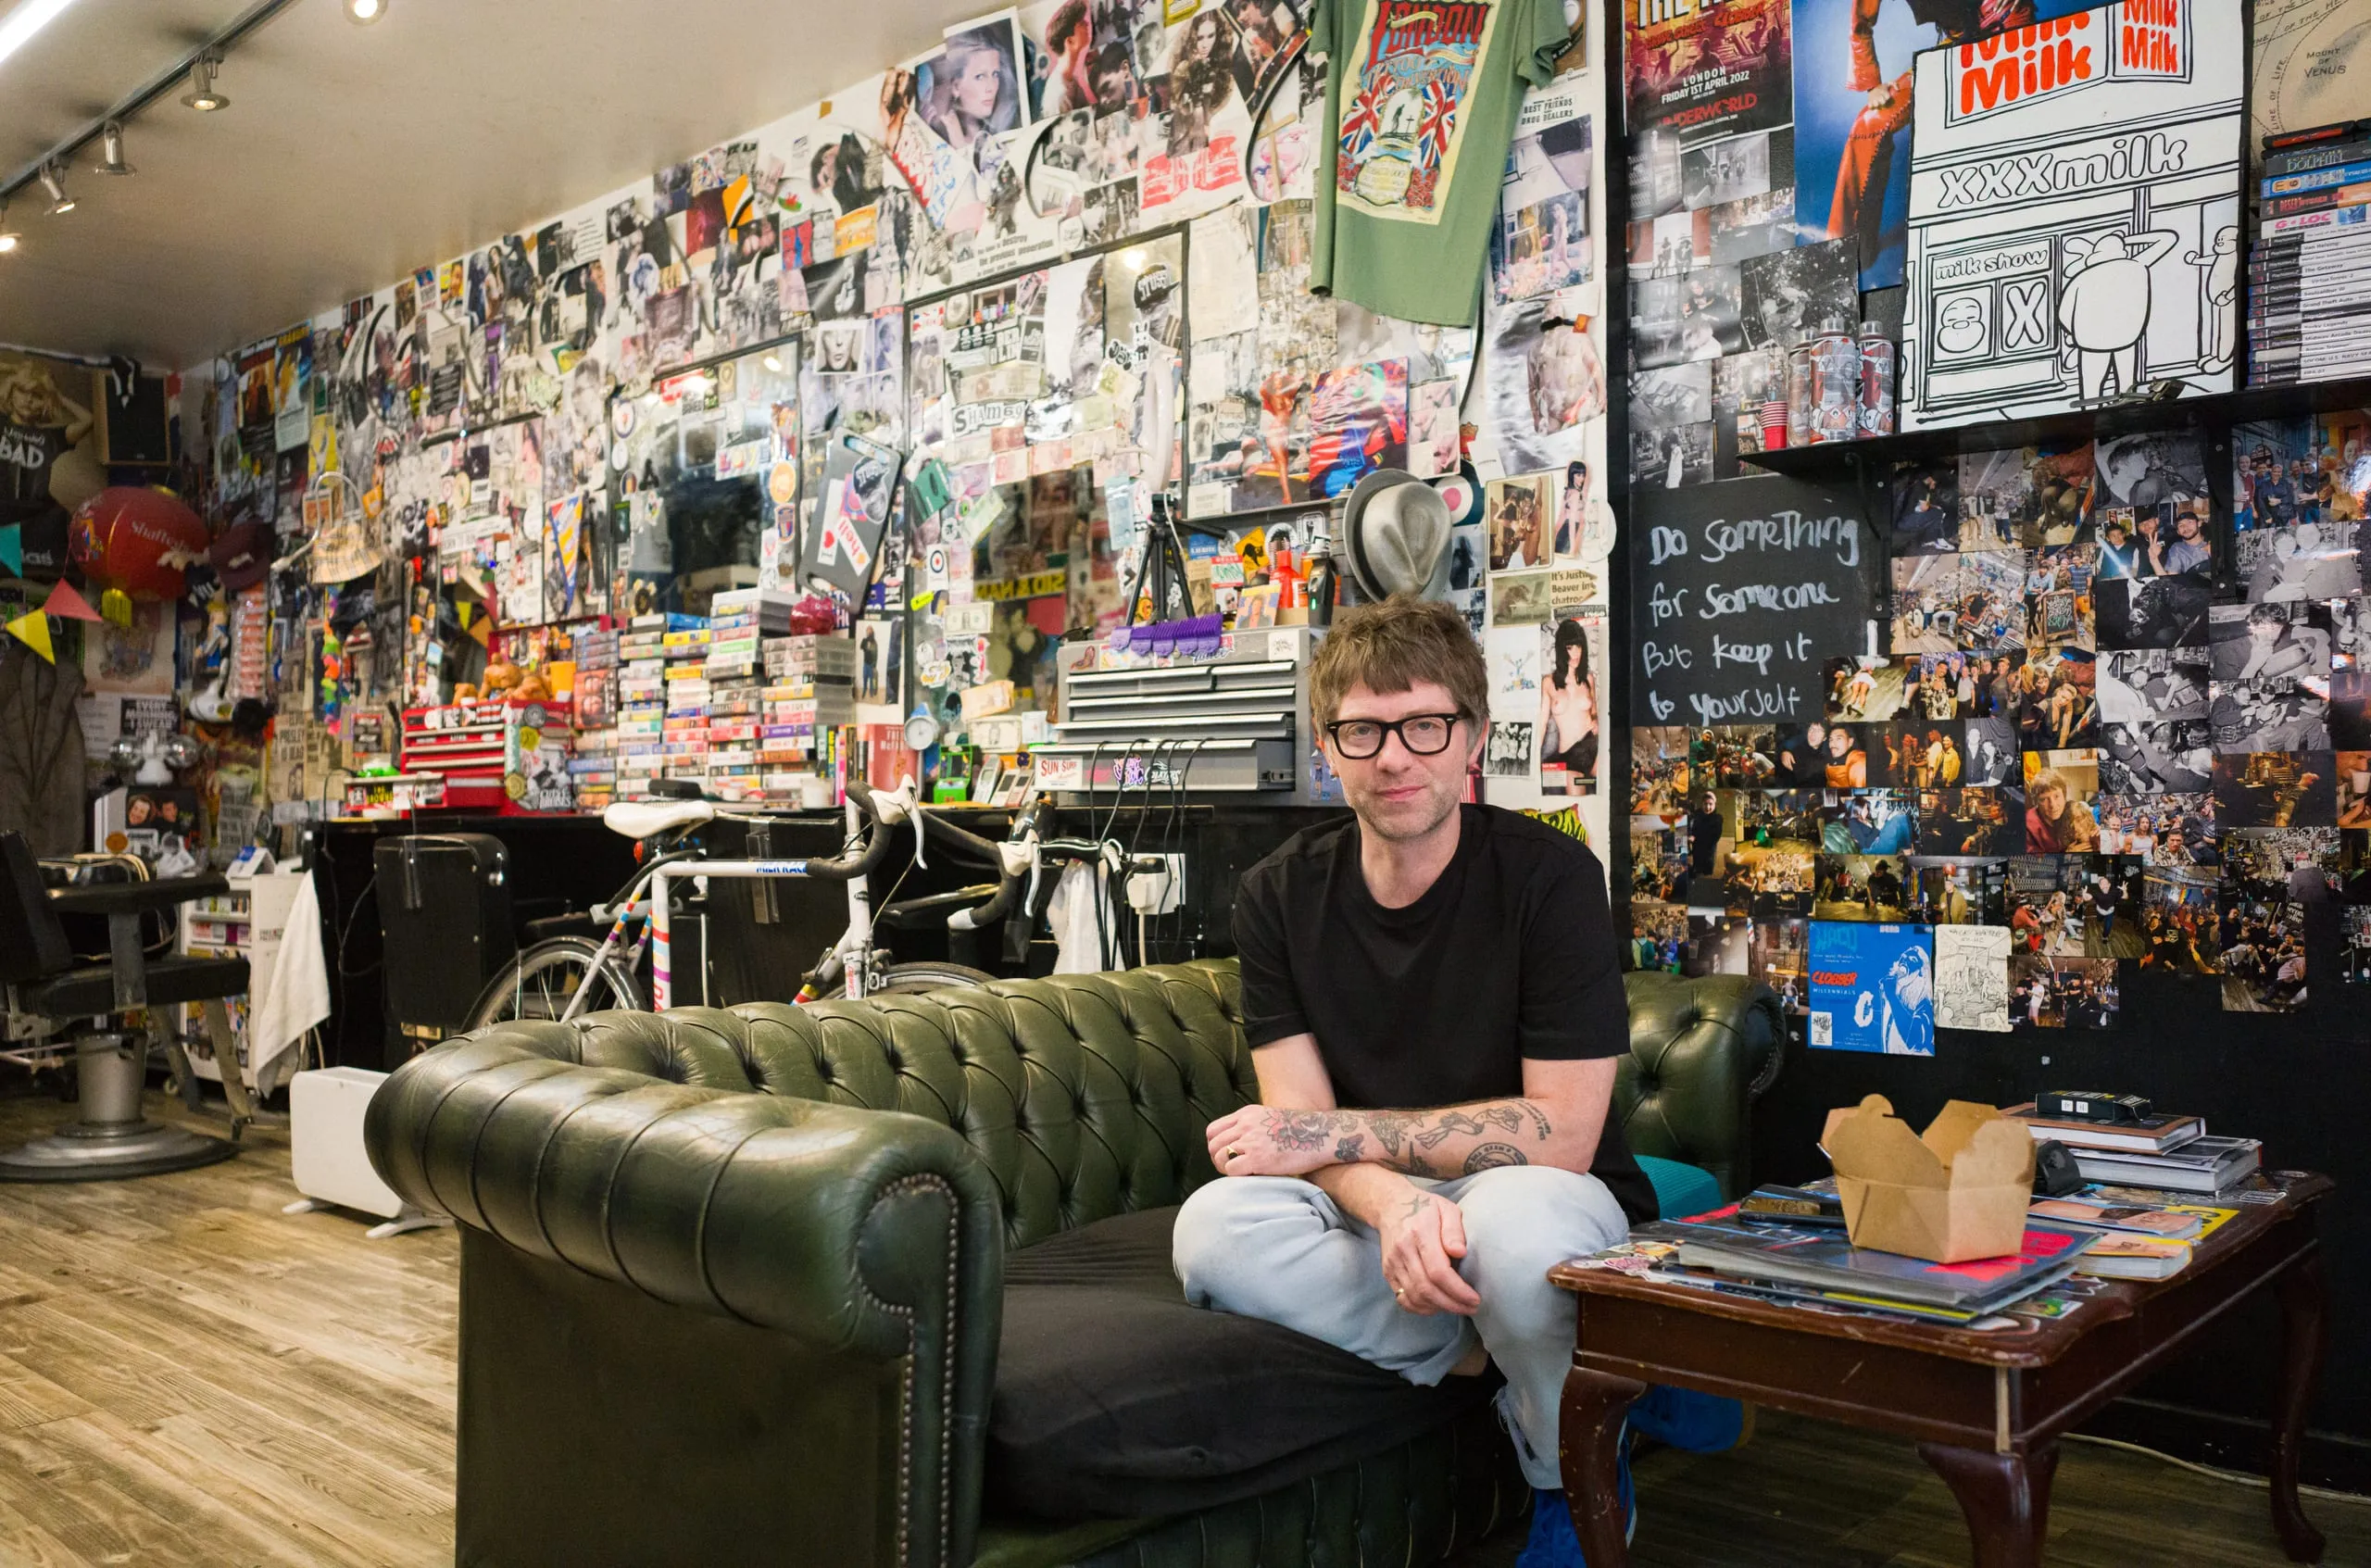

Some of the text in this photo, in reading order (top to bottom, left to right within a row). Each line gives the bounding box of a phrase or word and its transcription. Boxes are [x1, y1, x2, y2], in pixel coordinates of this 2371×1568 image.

[1362, 1, 1490, 74] LONDON
[2123, 25, 2177, 73] Milk
[2306, 48, 2340, 59] MOUNT
[1683, 66, 1726, 87] LONDON
[1961, 38, 2091, 114] Milk
[2304, 65, 2347, 79] VENUS
[1662, 88, 1690, 105] FRIDAY
[1704, 80, 1729, 92] APRIL
[1730, 70, 1750, 85] 2022
[1521, 109, 1573, 125] DRUG DEALERS
[1524, 105, 1541, 114] BEST
[1544, 98, 1573, 110] FRIENDS
[2268, 108, 2280, 130] LINE
[1935, 246, 2048, 281] milk show
[2005, 282, 2047, 348] X
[1, 435, 44, 470] BAD
[1650, 525, 1687, 565] Do
[1551, 571, 1563, 581] It's
[1551, 583, 1579, 594] Beaver
[1649, 582, 1688, 627] for
[1642, 641, 1692, 678] But
[1713, 634, 1773, 675] keep
[1041, 759, 1077, 777] SUN SURF
[1812, 970, 1858, 987] CLOBBER
[1813, 987, 1857, 996] MILLENNIALS
